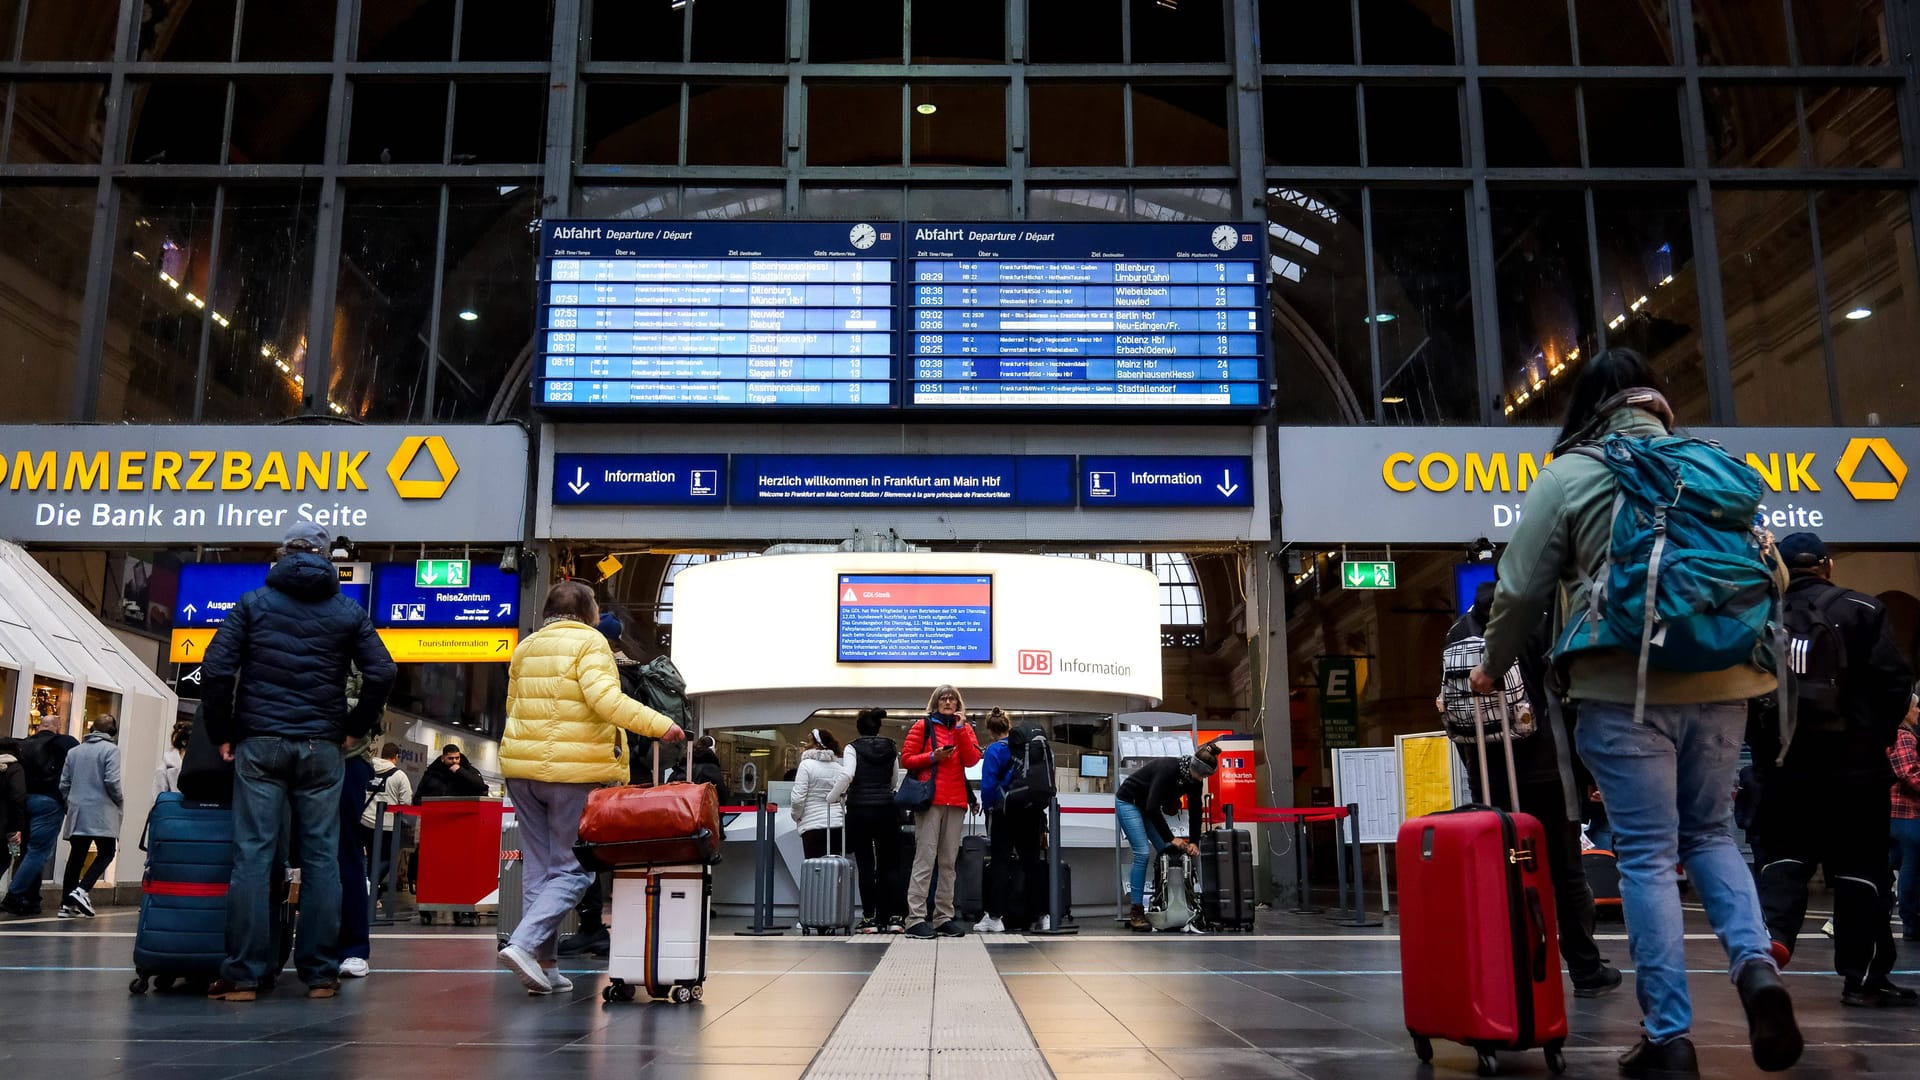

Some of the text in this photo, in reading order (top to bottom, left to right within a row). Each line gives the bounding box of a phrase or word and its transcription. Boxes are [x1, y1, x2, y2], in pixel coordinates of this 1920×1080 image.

[553, 227, 692, 240] Abfahrt Departure / Départ
[915, 228, 1054, 242] Abfahrt Departure / Départ
[1115, 264, 1224, 273] Dillenburg 16
[921, 273, 943, 281] 08:29
[1116, 274, 1169, 283] Limburg(Lahn)
[752, 287, 791, 295] Dillenburg
[1116, 288, 1167, 296] Wiebelsbach
[556, 295, 577, 303] 07:53
[920, 311, 943, 319] 09:02
[751, 321, 780, 330] Dieburg
[920, 321, 943, 329] 09:06
[1116, 322, 1180, 331] Neu-Edingen/Fr.
[750, 335, 800, 343] Saarbrücken
[1117, 336, 1149, 344] Koblenz
[1152, 336, 1165, 344] Hbf
[750, 345, 778, 353] Eltville
[1117, 346, 1176, 354] Erbach(Odenw)
[1117, 360, 1140, 368] Mainz
[1144, 360, 1157, 368] Hbf
[749, 370, 775, 379] Siegen
[1117, 370, 1194, 378] Babenhausen(Hess)
[550, 382, 573, 390] 08:23
[749, 384, 820, 392] Assmannshausen
[920, 384, 942, 392] 09:51
[550, 392, 572, 400] 08:29
[749, 394, 776, 403] Treysa
[0, 451, 370, 490] MMERZBANK
[604, 470, 675, 483] Information
[759, 476, 1001, 486] Herzlich willkommen in Frankfurt am Main Hbf
[1131, 472, 1202, 485] Information
[35, 503, 367, 526] Die Bank an Ihrer Seite
[1493, 504, 1521, 527] Di
[437, 593, 490, 602] ReiseZentrum
[1023, 655, 1048, 671] DB
[1060, 658, 1131, 677] Information
[1327, 670, 1349, 696] E
